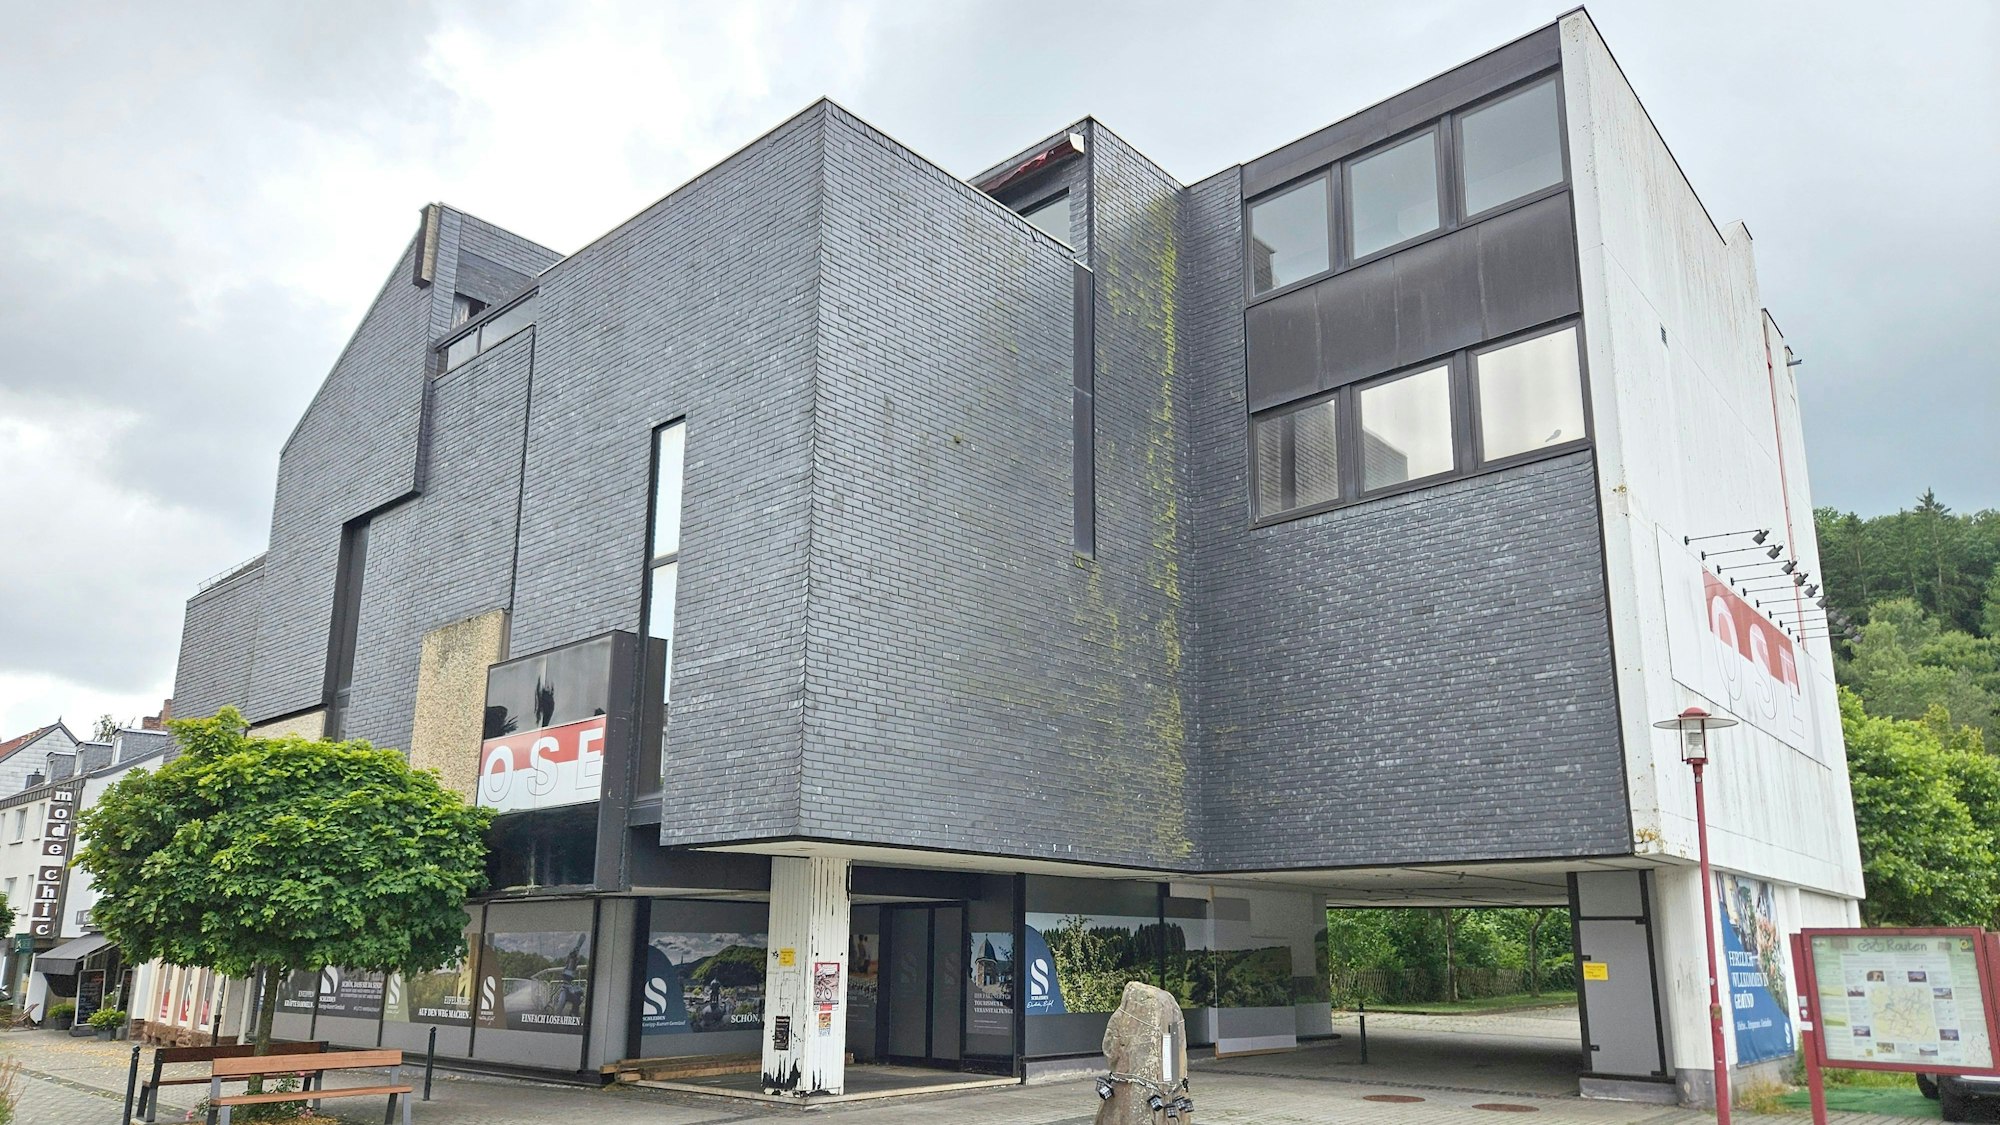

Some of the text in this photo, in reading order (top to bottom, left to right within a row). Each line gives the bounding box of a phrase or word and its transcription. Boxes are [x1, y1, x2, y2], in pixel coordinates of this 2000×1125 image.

[35, 791, 72, 935] mode chic
[1887, 939, 1927, 951] Routen
[418, 1008, 428, 1016] AUF
[428, 1009, 437, 1017] DEN
[438, 1009, 448, 1018] WEG
[521, 1013, 546, 1024] EINFACH
[730, 1012, 760, 1024] SCHÖN,
